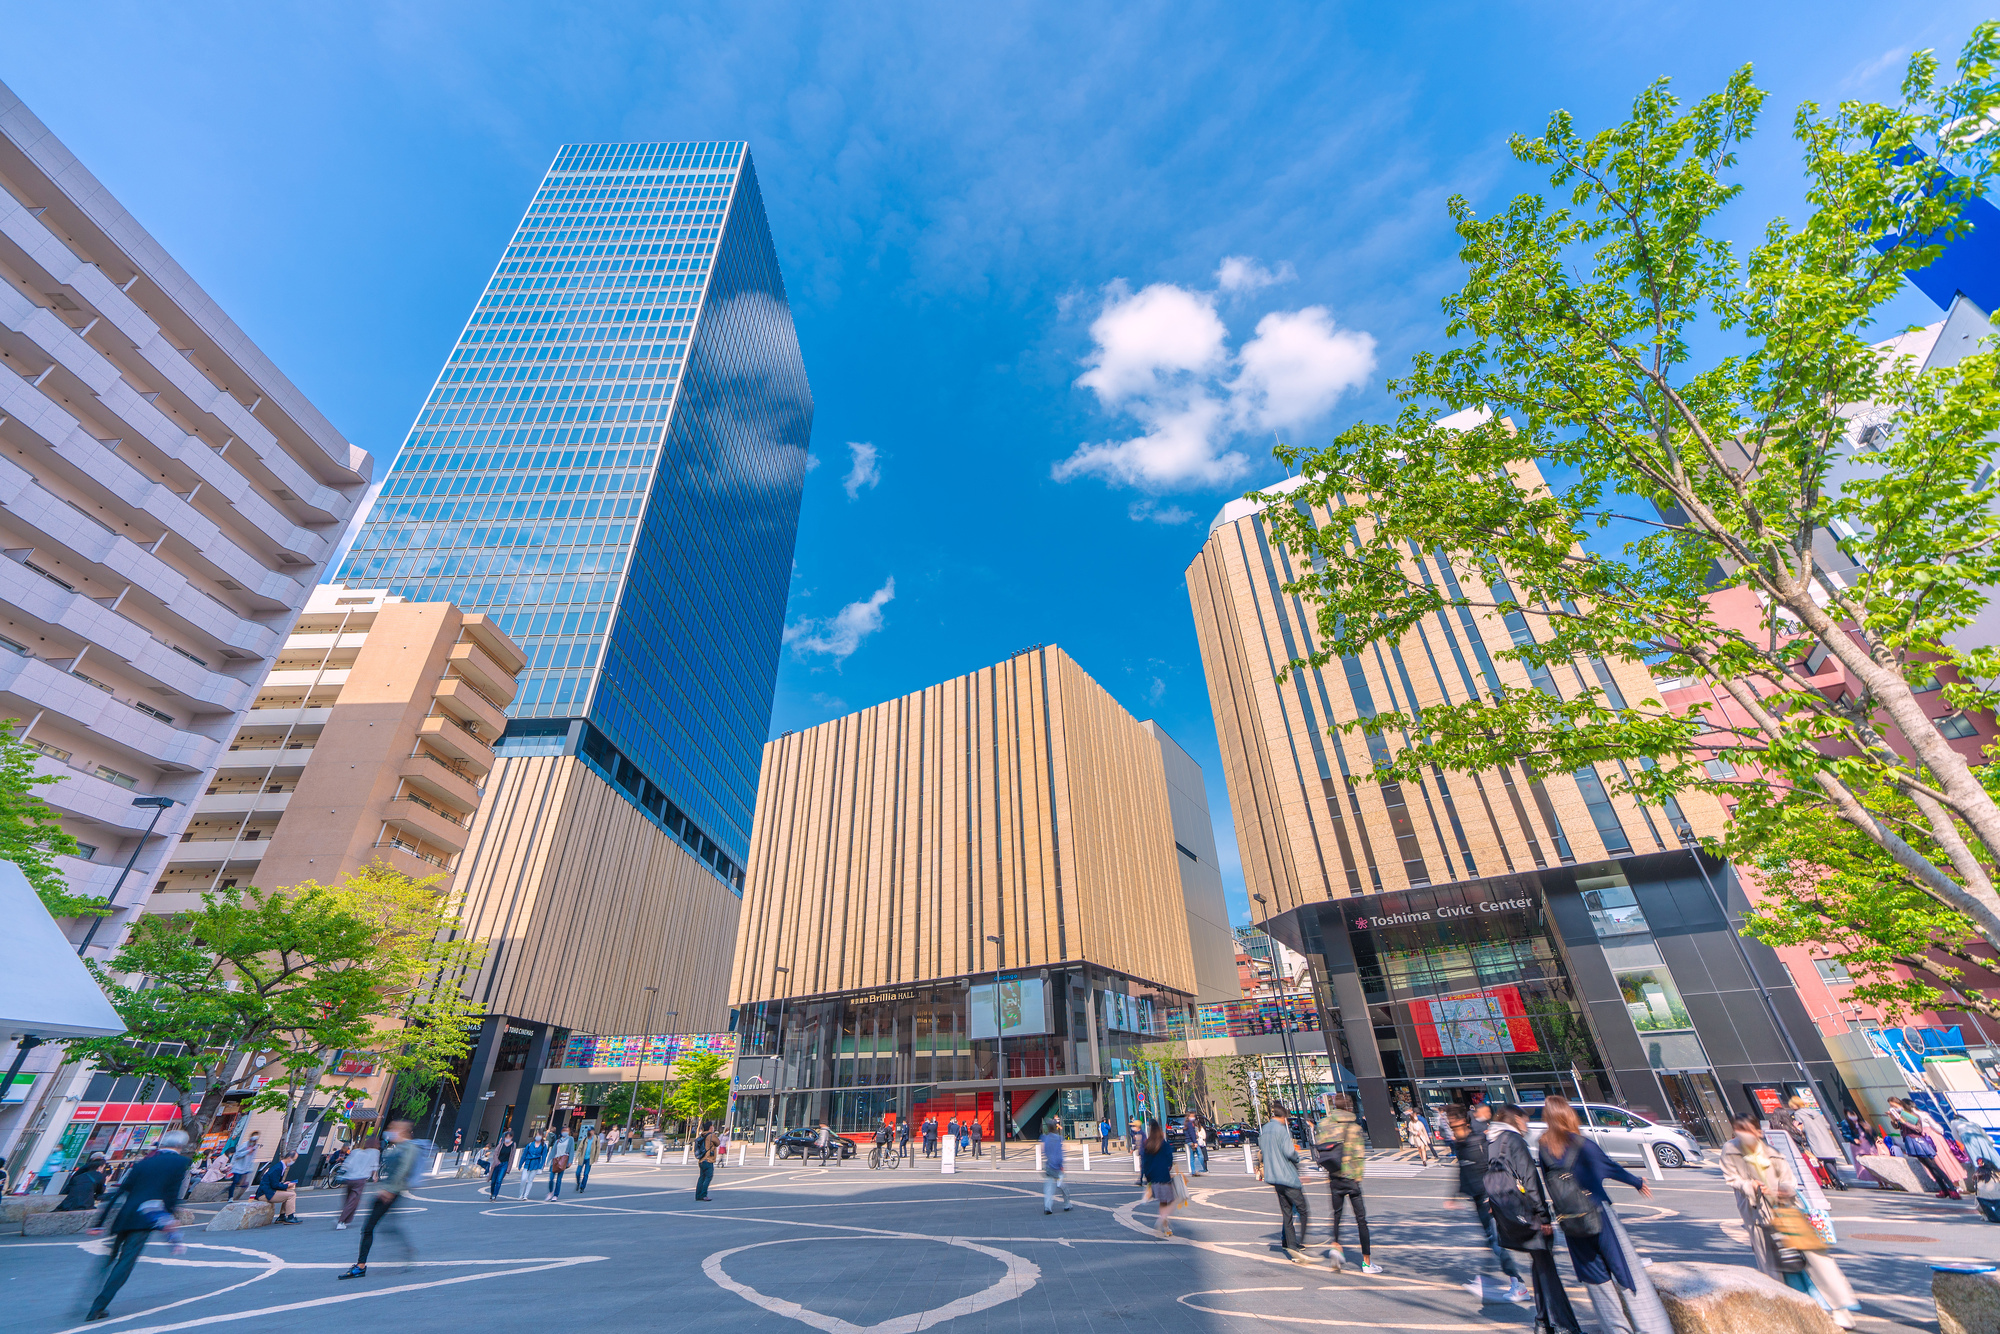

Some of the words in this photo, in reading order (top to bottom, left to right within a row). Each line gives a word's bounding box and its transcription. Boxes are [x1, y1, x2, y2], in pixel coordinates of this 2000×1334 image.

[1370, 911, 1431, 927] Toshima
[1436, 904, 1474, 918] Civic
[1479, 897, 1532, 913] Center
[869, 993, 897, 1003] Brillia
[897, 991, 915, 1000] HALL
